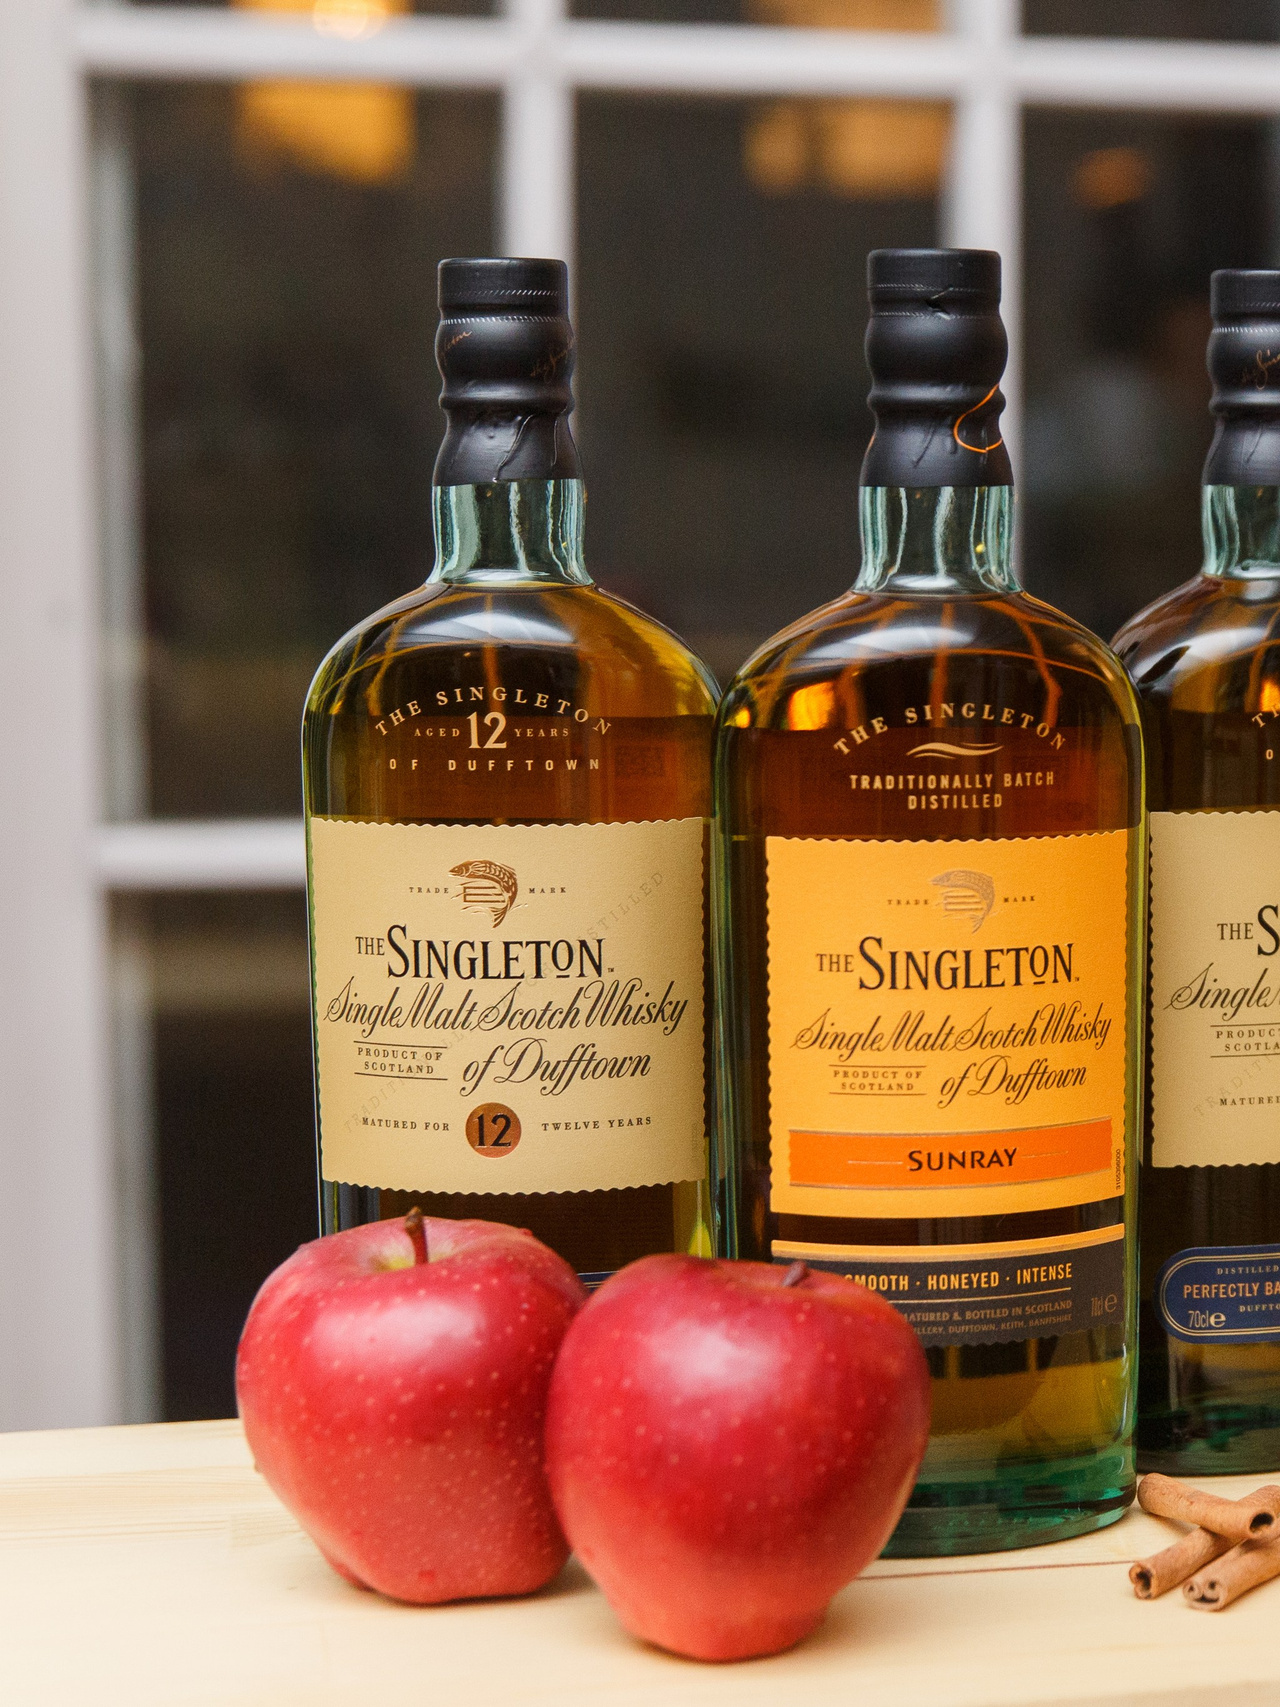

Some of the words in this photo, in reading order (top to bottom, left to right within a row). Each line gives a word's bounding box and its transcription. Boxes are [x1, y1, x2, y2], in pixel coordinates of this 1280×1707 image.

[375, 701, 421, 737] THE
[436, 686, 612, 736] SINGLETON
[414, 728, 461, 737] AGED
[466, 711, 508, 749] 12
[514, 728, 570, 737] YEARS
[833, 717, 888, 756] THE
[904, 702, 1066, 750] SINGLETON
[389, 759, 419, 770] OF
[448, 758, 600, 771] DUFFTOWN
[850, 774, 993, 790] TRADITIONALLY
[1003, 772, 1054, 787] BATCH
[908, 794, 1003, 810] DISTILLED
[1003, 895, 1036, 903] MARK
[1217, 922, 1254, 941] THE
[355, 935, 385, 956] THE
[386, 924, 606, 980] SINGLETON
[816, 952, 854, 973] THE
[858, 936, 1074, 990] SINGLETON
[1163, 962, 1271, 1021] Single
[323, 976, 402, 1039] Single
[398, 981, 477, 1031] Malt
[471, 981, 580, 1032] Scotch
[584, 977, 689, 1036] Whisky
[789, 1007, 883, 1061] Single
[879, 1010, 955, 1053] Malt
[950, 1007, 1038, 1052] Scotch
[1038, 1000, 1112, 1050] Whisky
[357, 1047, 418, 1060] PRODUCT
[425, 1051, 443, 1061] OF
[364, 1061, 434, 1074] SCOTLAND
[460, 1044, 505, 1096] of
[495, 1037, 652, 1096] Dufftown
[833, 1070, 898, 1080] PRODUCT
[905, 1070, 923, 1079] OF
[841, 1081, 914, 1091] SCOTLAND
[937, 1063, 977, 1109] of
[967, 1054, 1087, 1105] Dufftown
[362, 1117, 418, 1130] MATURED
[424, 1122, 450, 1131] FOR
[475, 1114, 512, 1148] 12
[542, 1121, 600, 1132] TWELVE
[607, 1117, 652, 1128] YEARS
[907, 1147, 1018, 1171] SUNRAY
[927, 1272, 999, 1290] HONEYED
[1016, 1262, 1073, 1284] INTENSE
[1217, 1265, 1280, 1275] DISTILLED
[1183, 1283, 1259, 1299] PERFECTLY
[965, 1307, 1009, 1320] BOTTLED
[1011, 1306, 1022, 1316] IN
[1026, 1300, 1073, 1315] SCOTLAND
